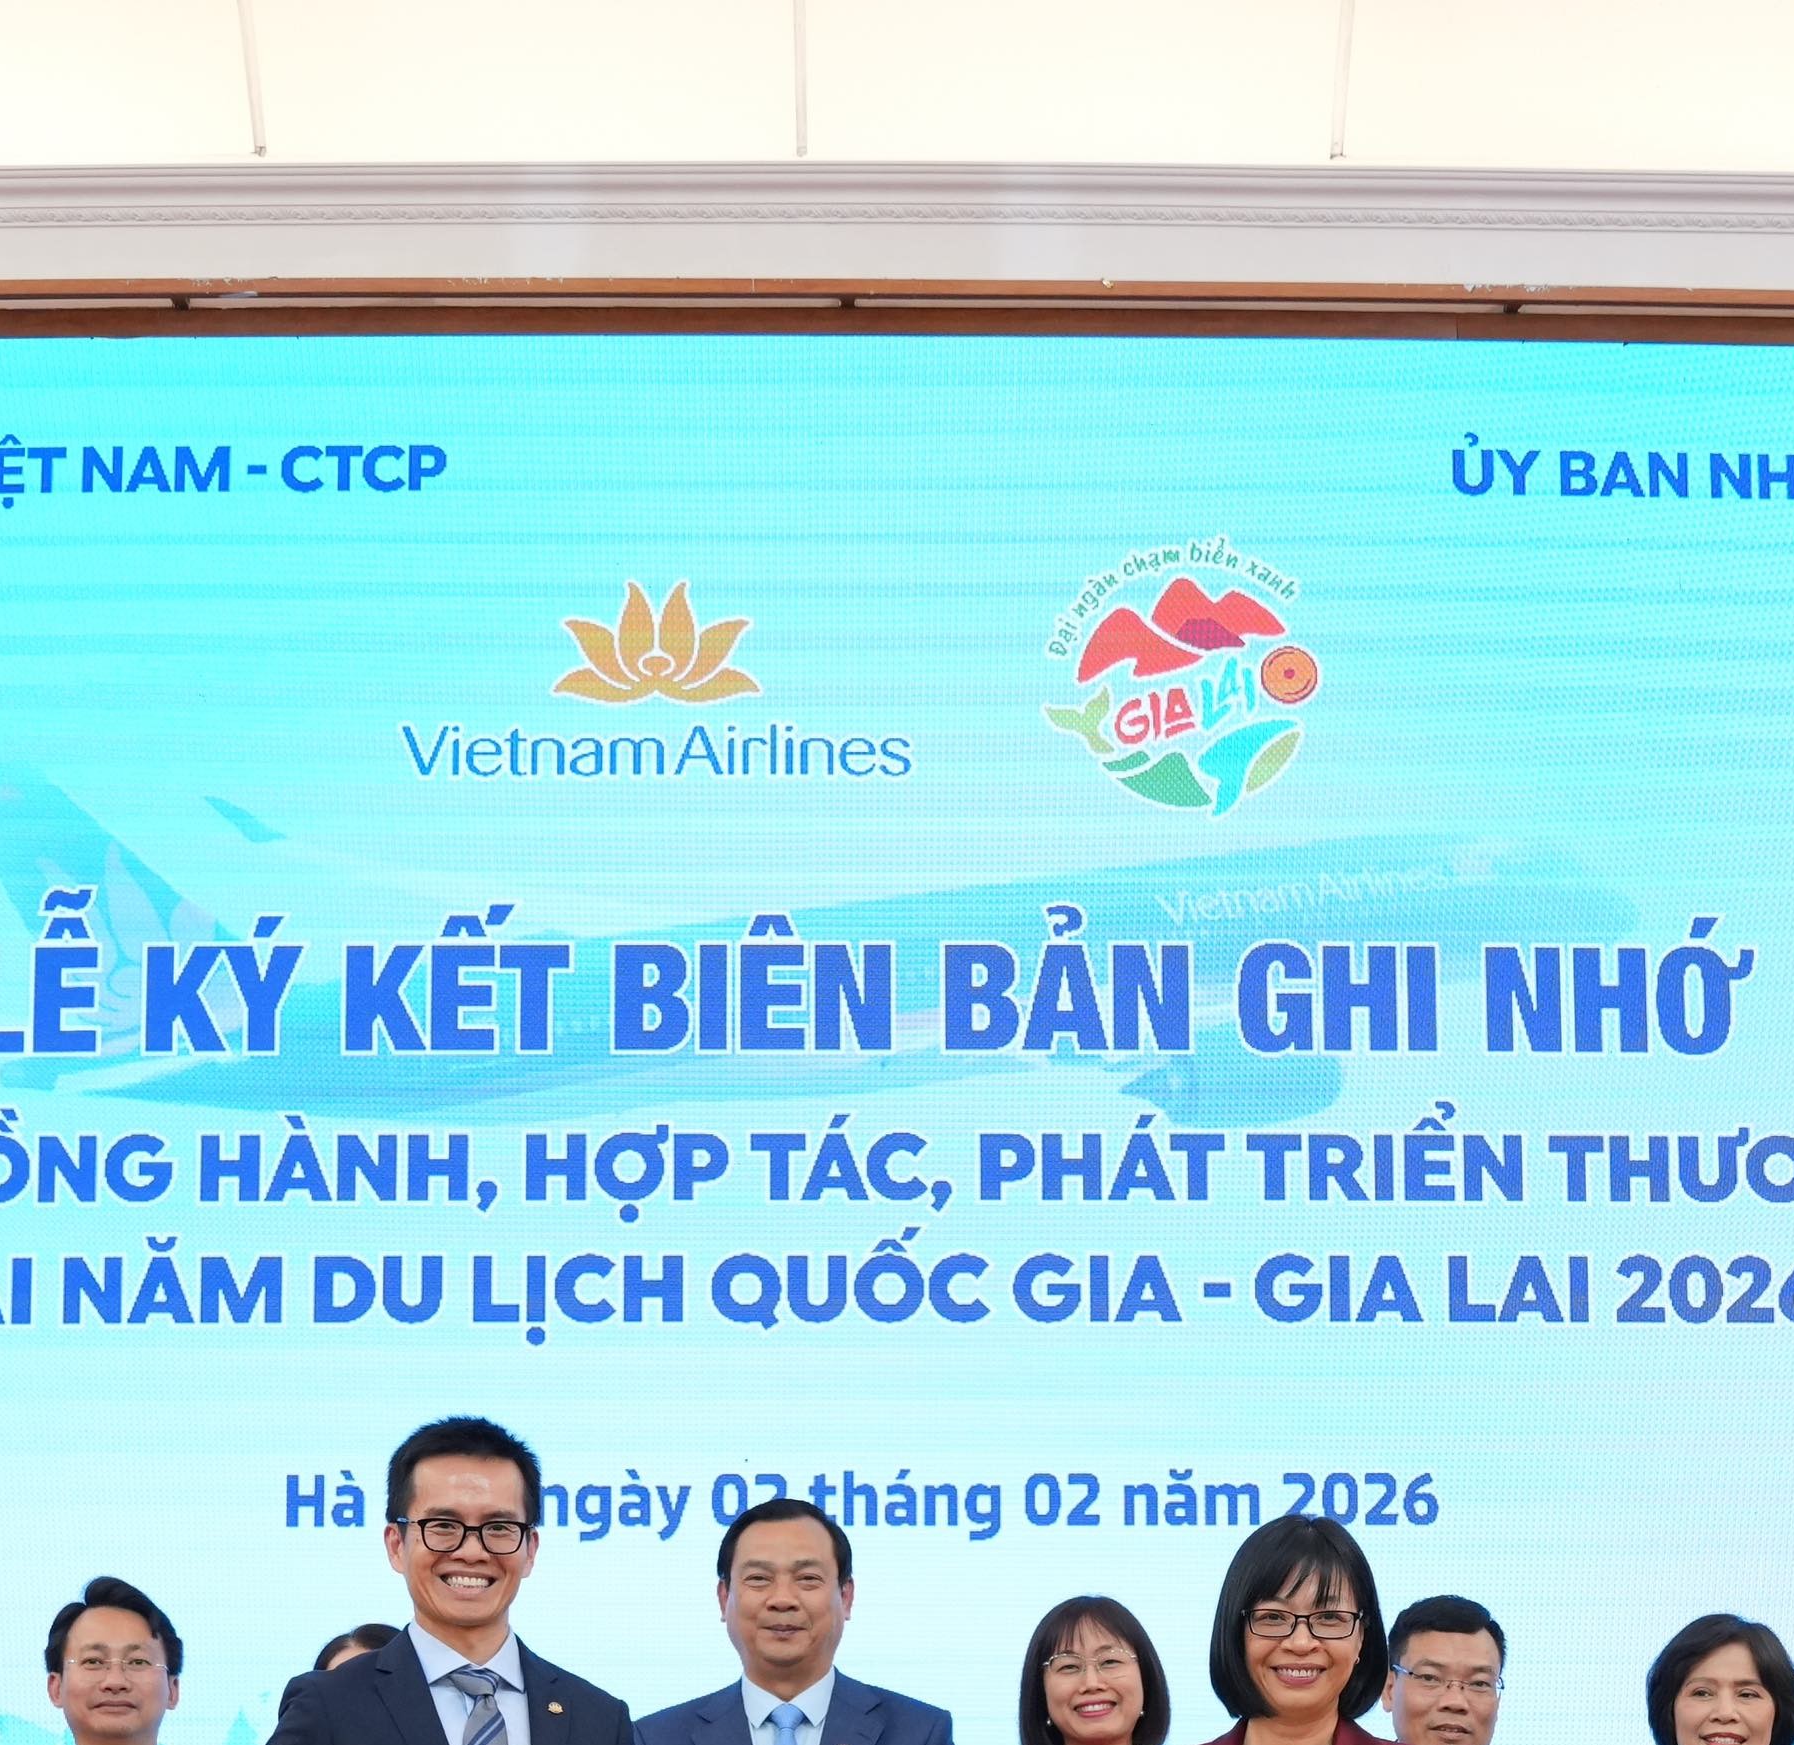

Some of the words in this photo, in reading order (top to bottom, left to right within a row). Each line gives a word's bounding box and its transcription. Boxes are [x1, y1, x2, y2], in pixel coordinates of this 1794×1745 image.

[82, 445, 232, 494] NAM
[247, 466, 267, 476] -
[281, 444, 448, 493] CTCP
[1451, 431, 1540, 497] ỦY
[1559, 450, 1690, 499] BAN
[1189, 537, 1239, 569] biển
[1246, 561, 1297, 600] xanh
[1114, 687, 1195, 745] GIA
[1200, 656, 1255, 731] LAI
[402, 724, 666, 777] Vietnam
[674, 723, 912, 777] Airlines
[145, 916, 304, 1053] KÝ
[345, 904, 570, 1052] KẾT
[614, 914, 892, 1051] BIÊN
[944, 905, 1190, 1052] BẢN
[1238, 943, 1437, 1053] GHI
[1485, 916, 1755, 1055] NHỚ
[199, 1115, 498, 1212] HÀNH,
[525, 1124, 729, 1223] HỢP
[750, 1114, 952, 1212] TÁC,
[979, 1114, 1225, 1201] PHÁT
[1246, 1100, 1523, 1202] TRIỂN
[62, 1236, 283, 1324] NĂM
[313, 1255, 443, 1324] DU
[472, 1253, 684, 1346] LỊCH
[711, 1227, 991, 1330] QUỐC
[1012, 1252, 1183, 1324] GIA
[1203, 1282, 1231, 1298] -
[1254, 1253, 1424, 1323] GIA
[1447, 1255, 1590, 1323] LAI
[286, 1470, 365, 1527] Hà
[536, 1468, 692, 1542] ngày
[808, 1468, 1001, 1541] tháng
[1025, 1473, 1101, 1526] 02
[1124, 1468, 1260, 1526] năm
[1283, 1472, 1439, 1527] 2026
